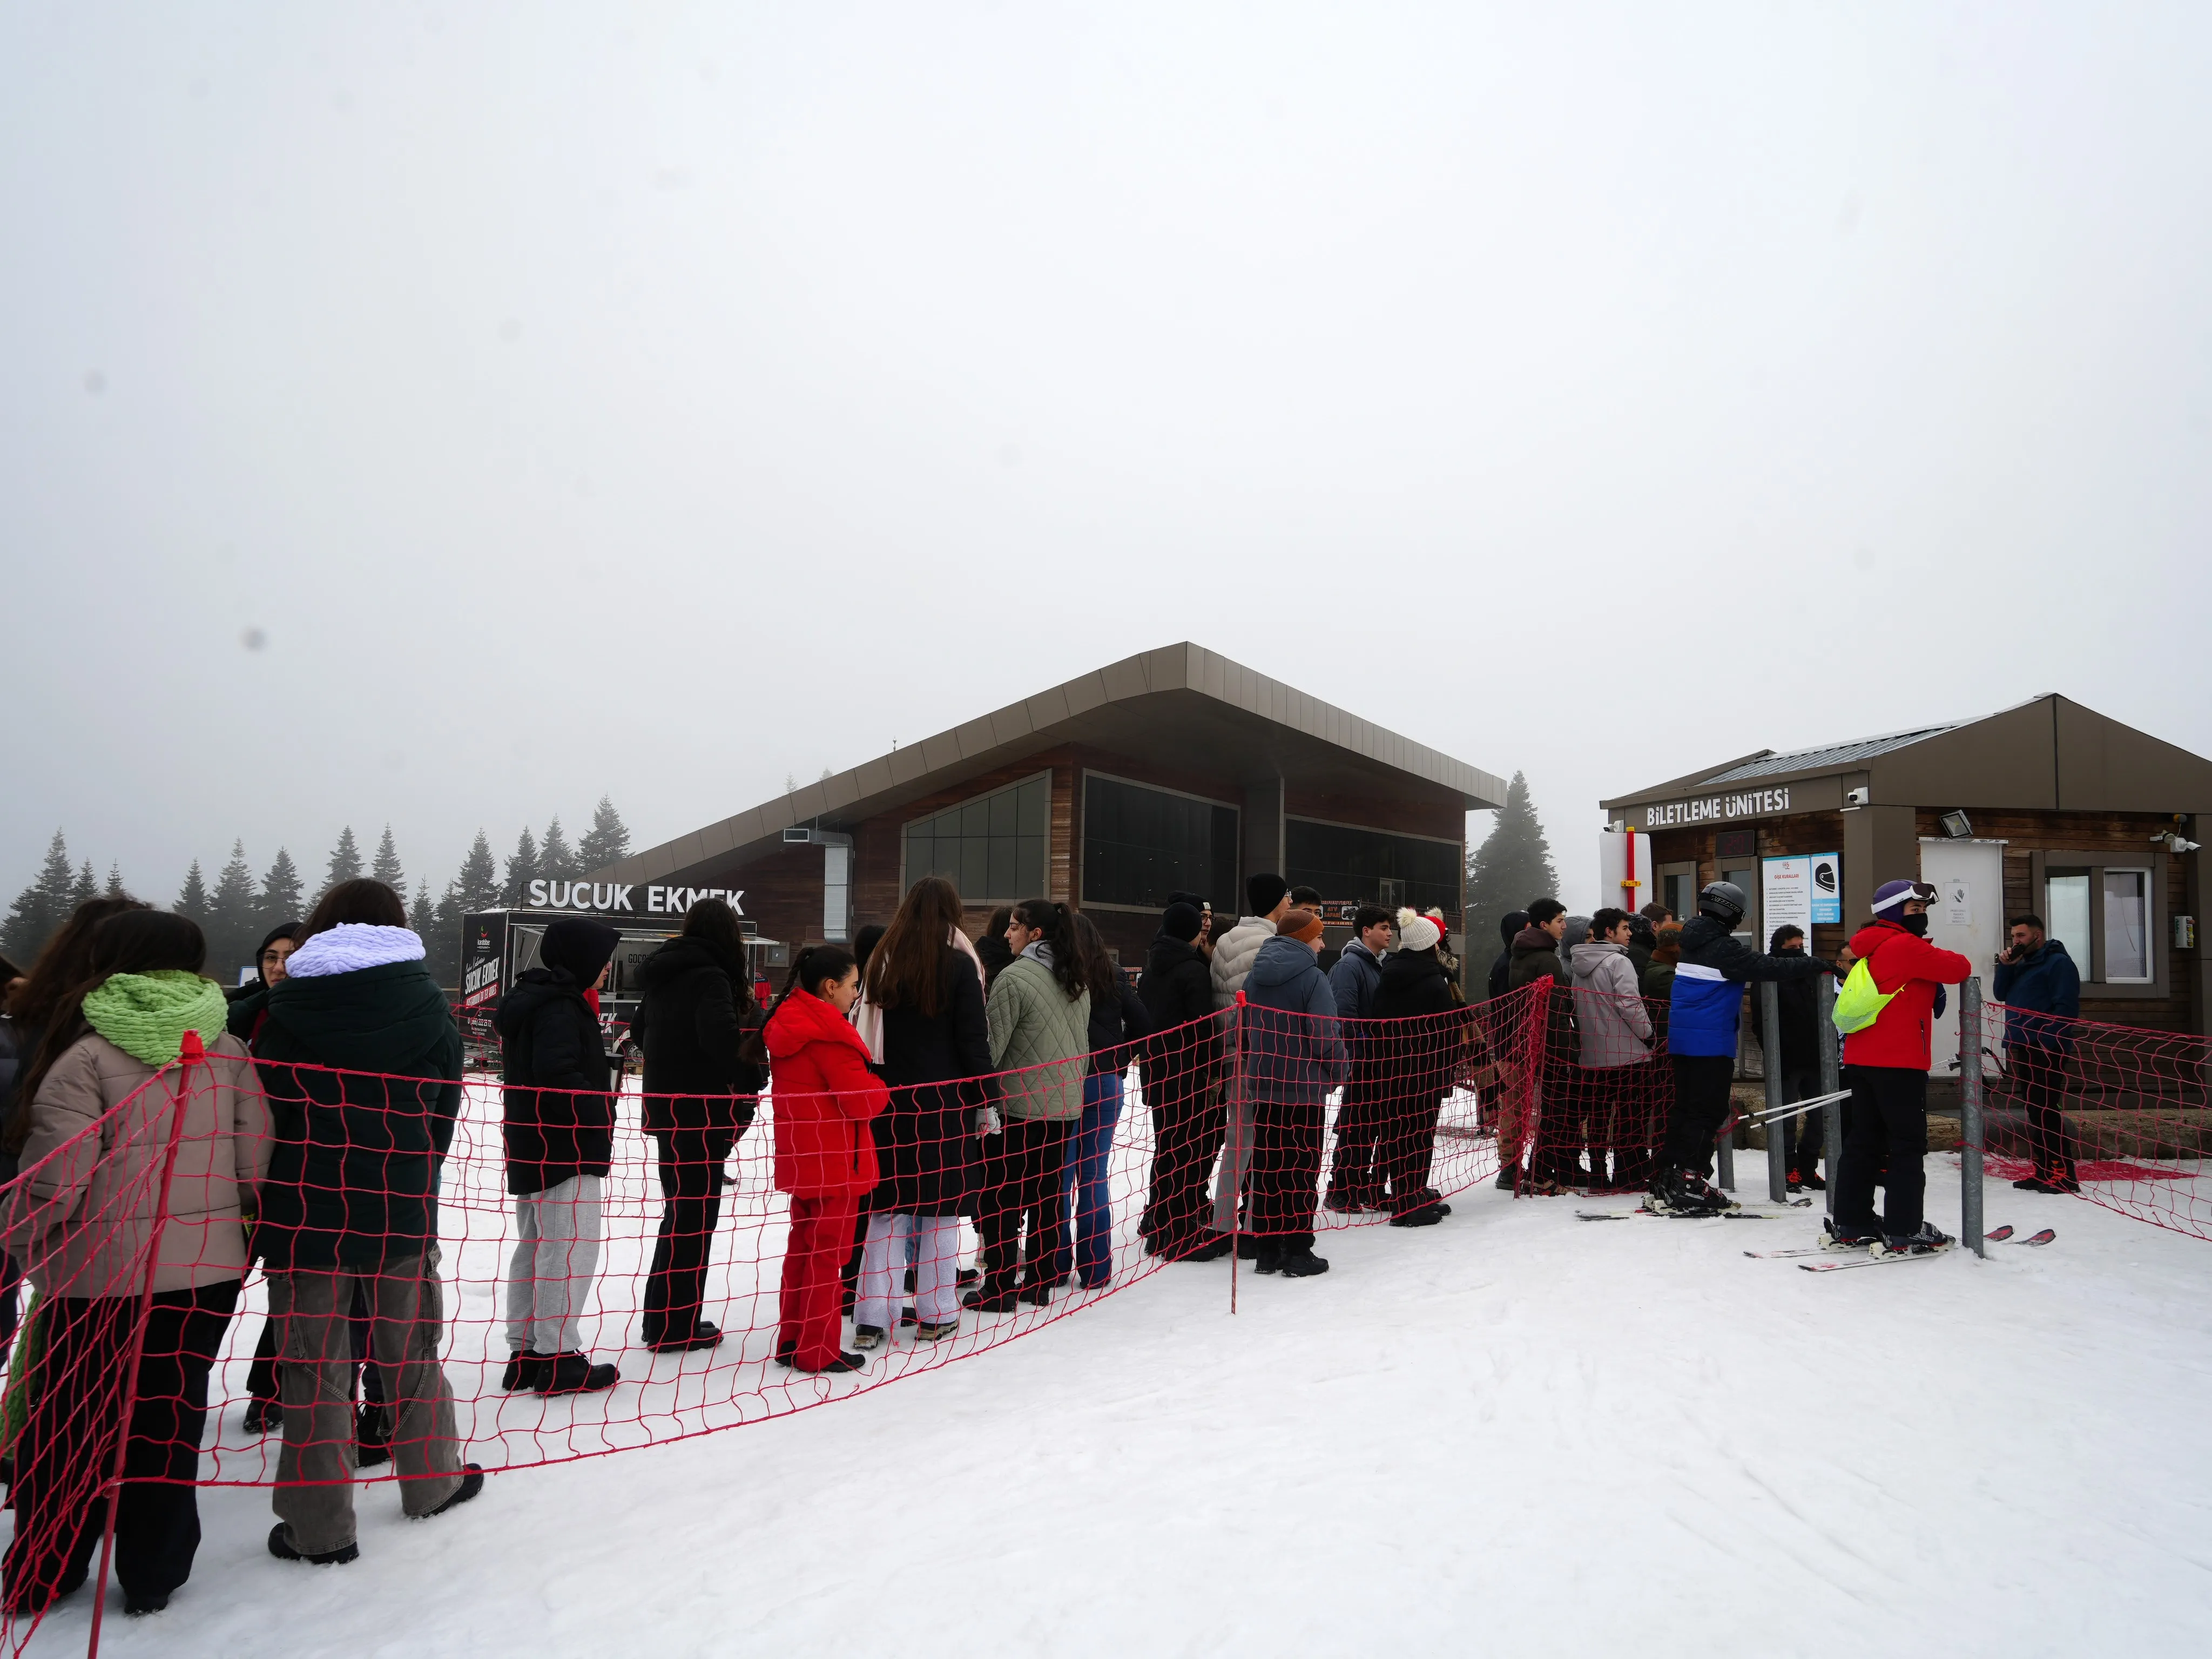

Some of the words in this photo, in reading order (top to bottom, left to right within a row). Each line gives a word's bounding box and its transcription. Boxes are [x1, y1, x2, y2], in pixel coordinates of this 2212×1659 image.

[1647, 798, 1721, 826] BİLETLEME
[1725, 787, 1790, 818] ÜNİTESİ
[529, 879, 634, 911] SUCUK
[465, 966, 482, 995] SUCUK
[481, 956, 500, 987] EKMEK
[488, 984, 497, 998] ADRES
